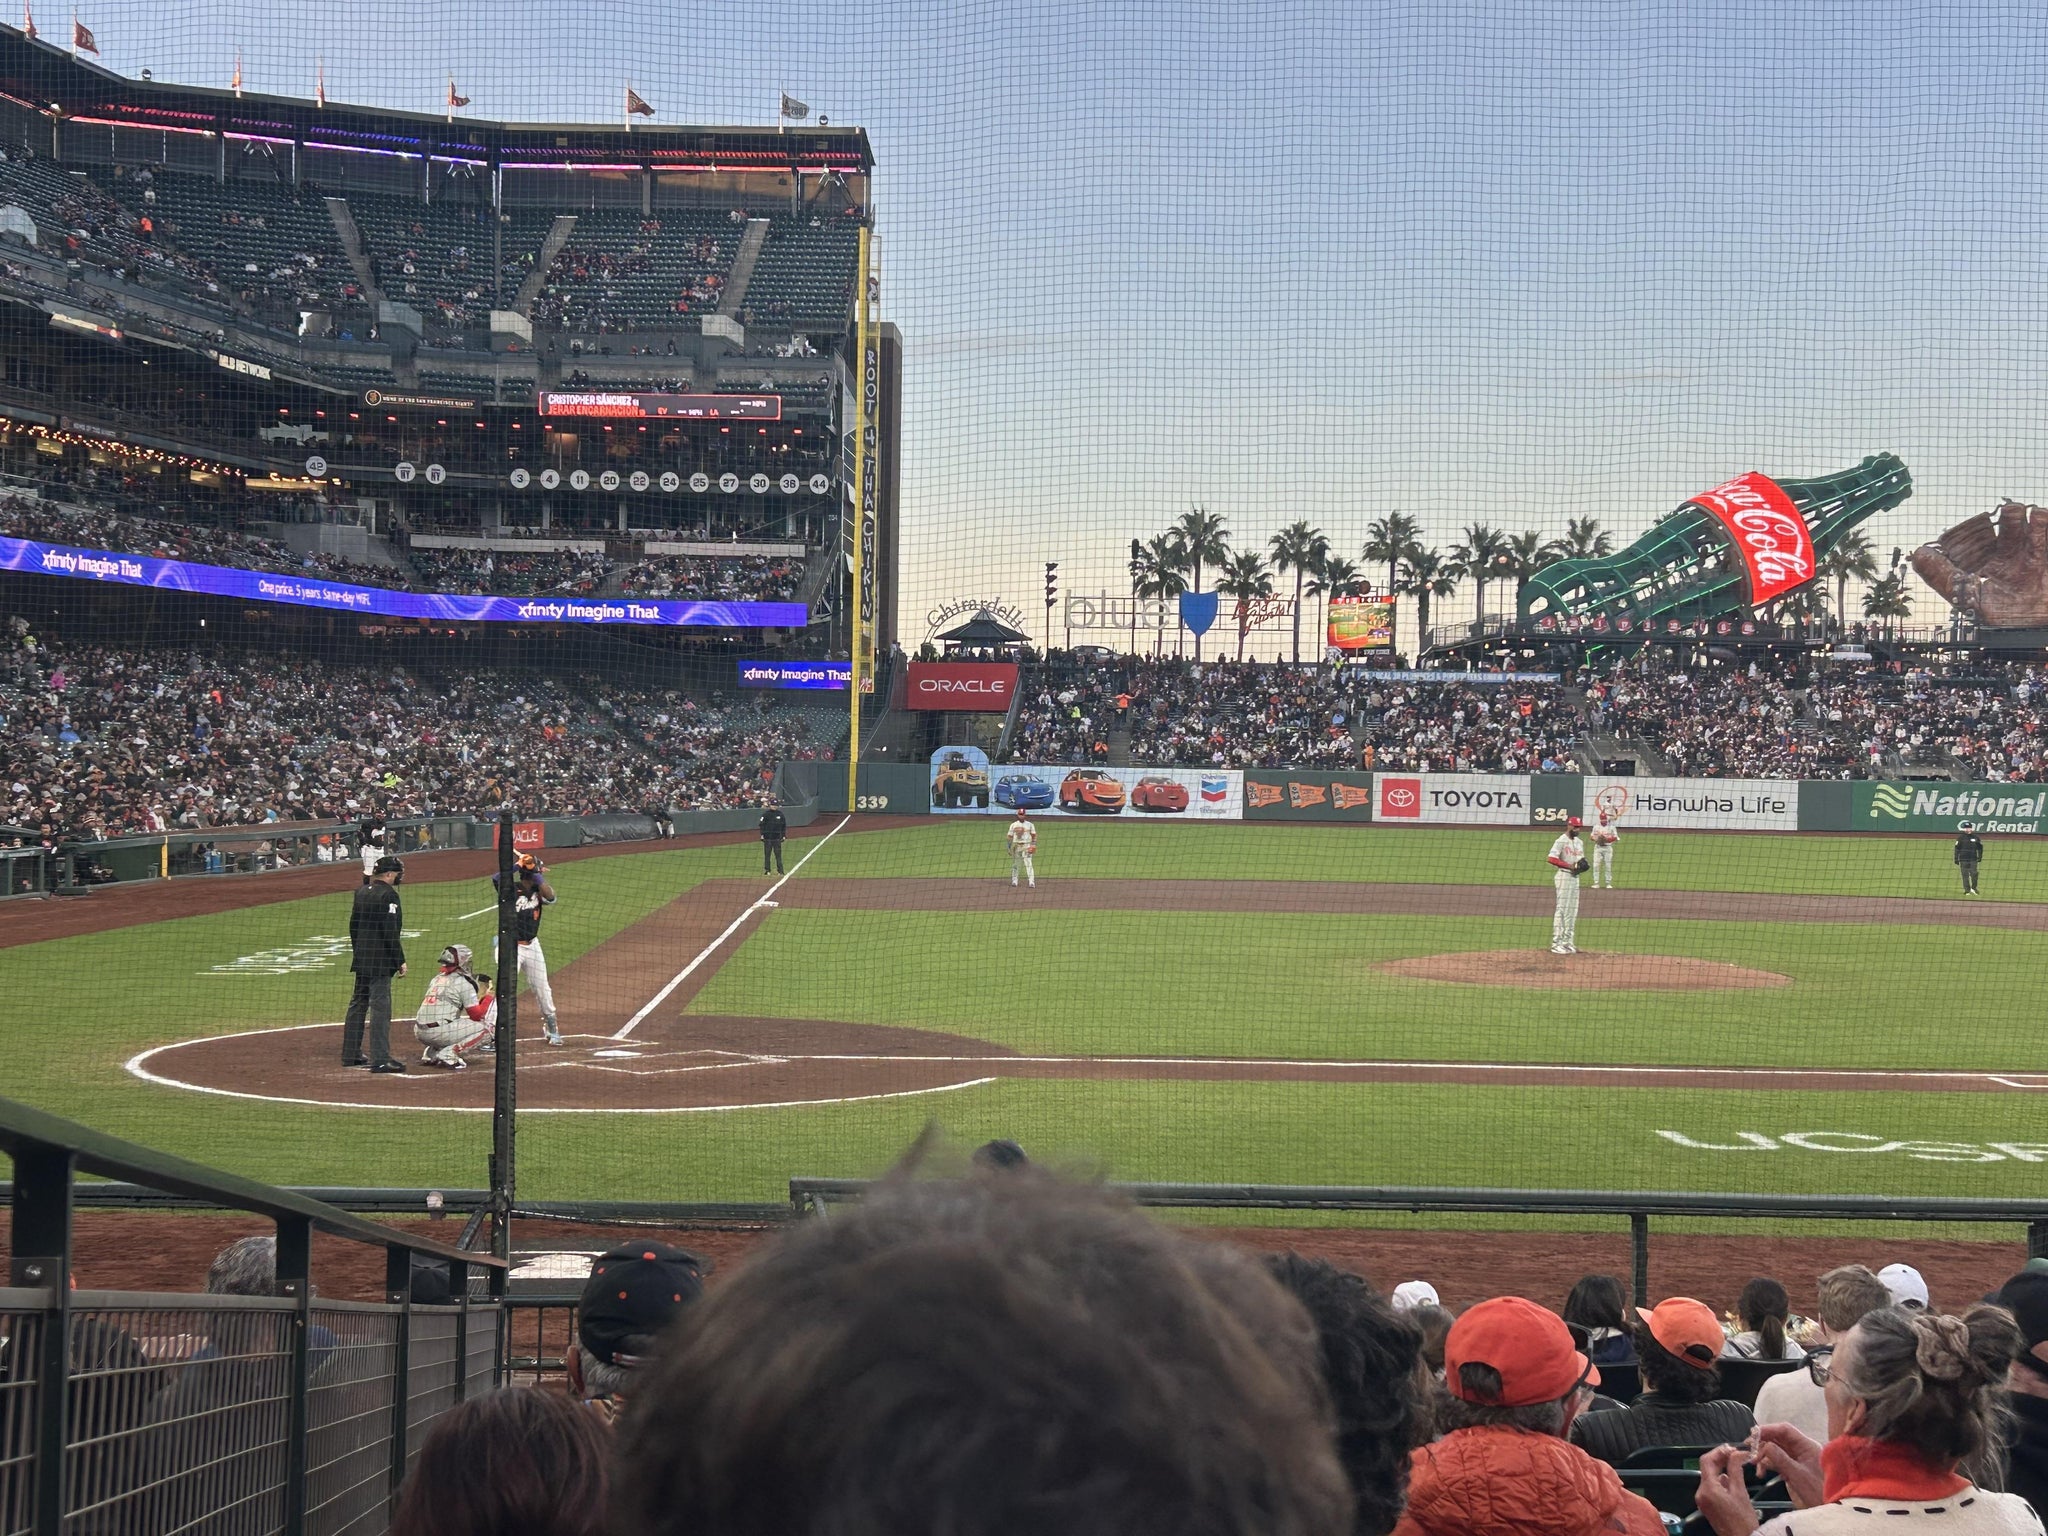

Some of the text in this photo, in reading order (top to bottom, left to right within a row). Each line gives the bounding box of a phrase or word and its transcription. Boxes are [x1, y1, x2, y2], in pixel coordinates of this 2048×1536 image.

[309, 462, 324, 471] 42
[517, 474, 523, 483] 3
[545, 474, 553, 484] 4
[576, 475, 584, 484] 11
[603, 476, 616, 485] 20
[633, 477, 646, 486] 22
[663, 477, 676, 486] 24
[693, 478, 706, 487] 25
[723, 478, 735, 487] 27
[753, 478, 766, 488] 30
[783, 478, 796, 488] 36
[812, 479, 826, 489] 44
[1700, 475, 1808, 585] oca-Cola
[42, 550, 142, 577] xfinity Imagine That
[862, 522, 874, 619] CHIKIN
[518, 602, 660, 621] xfinity Imagine That
[927, 596, 1026, 627] Ghirardelli
[1065, 589, 1170, 630] blue
[744, 668, 852, 682] xfinity Imagine That
[919, 679, 1005, 693] ORACLE
[857, 795, 888, 809] 339
[1430, 790, 1522, 808] TOYOTA
[1636, 794, 1785, 813] Hanwha Life
[1534, 808, 1568, 821] 354
[1986, 820, 2039, 833] Rental
